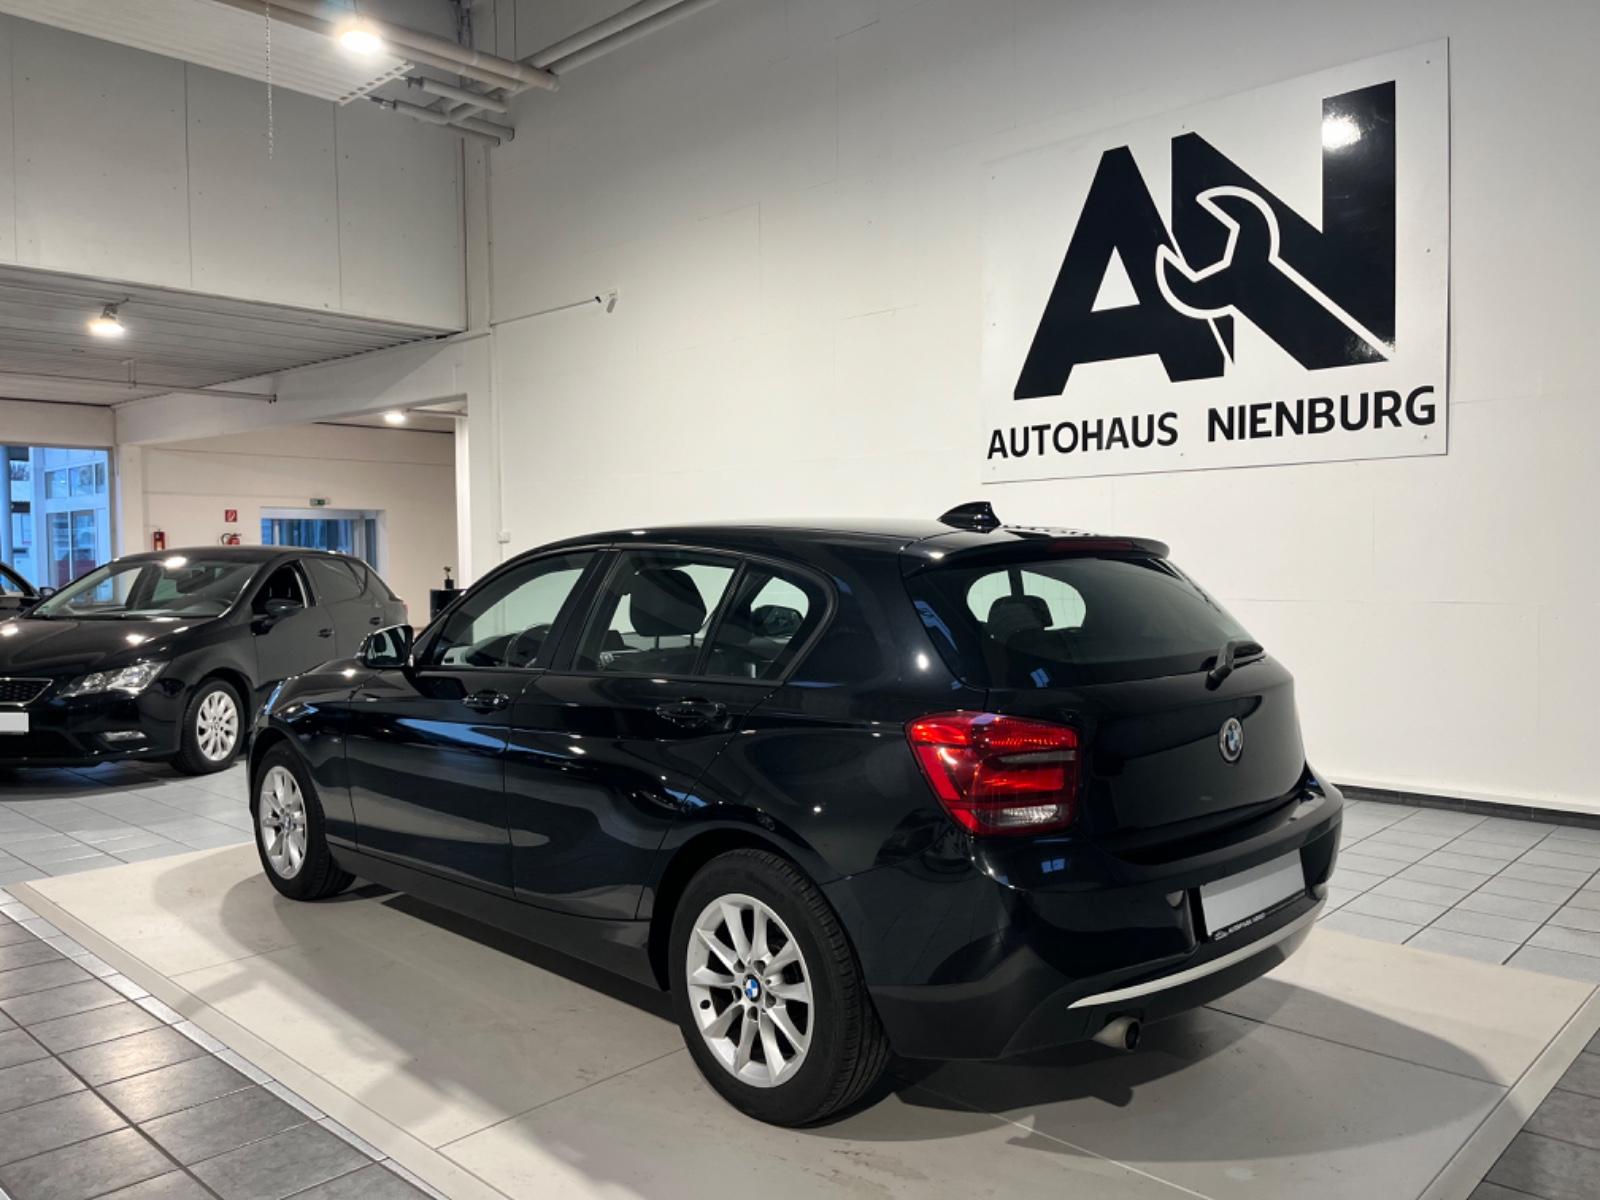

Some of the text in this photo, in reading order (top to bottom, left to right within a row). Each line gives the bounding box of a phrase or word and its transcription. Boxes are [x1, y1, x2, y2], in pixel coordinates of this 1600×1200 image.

[1014, 80, 1396, 400] AN
[987, 385, 1436, 460] AUTOHAUS NIENBURG
